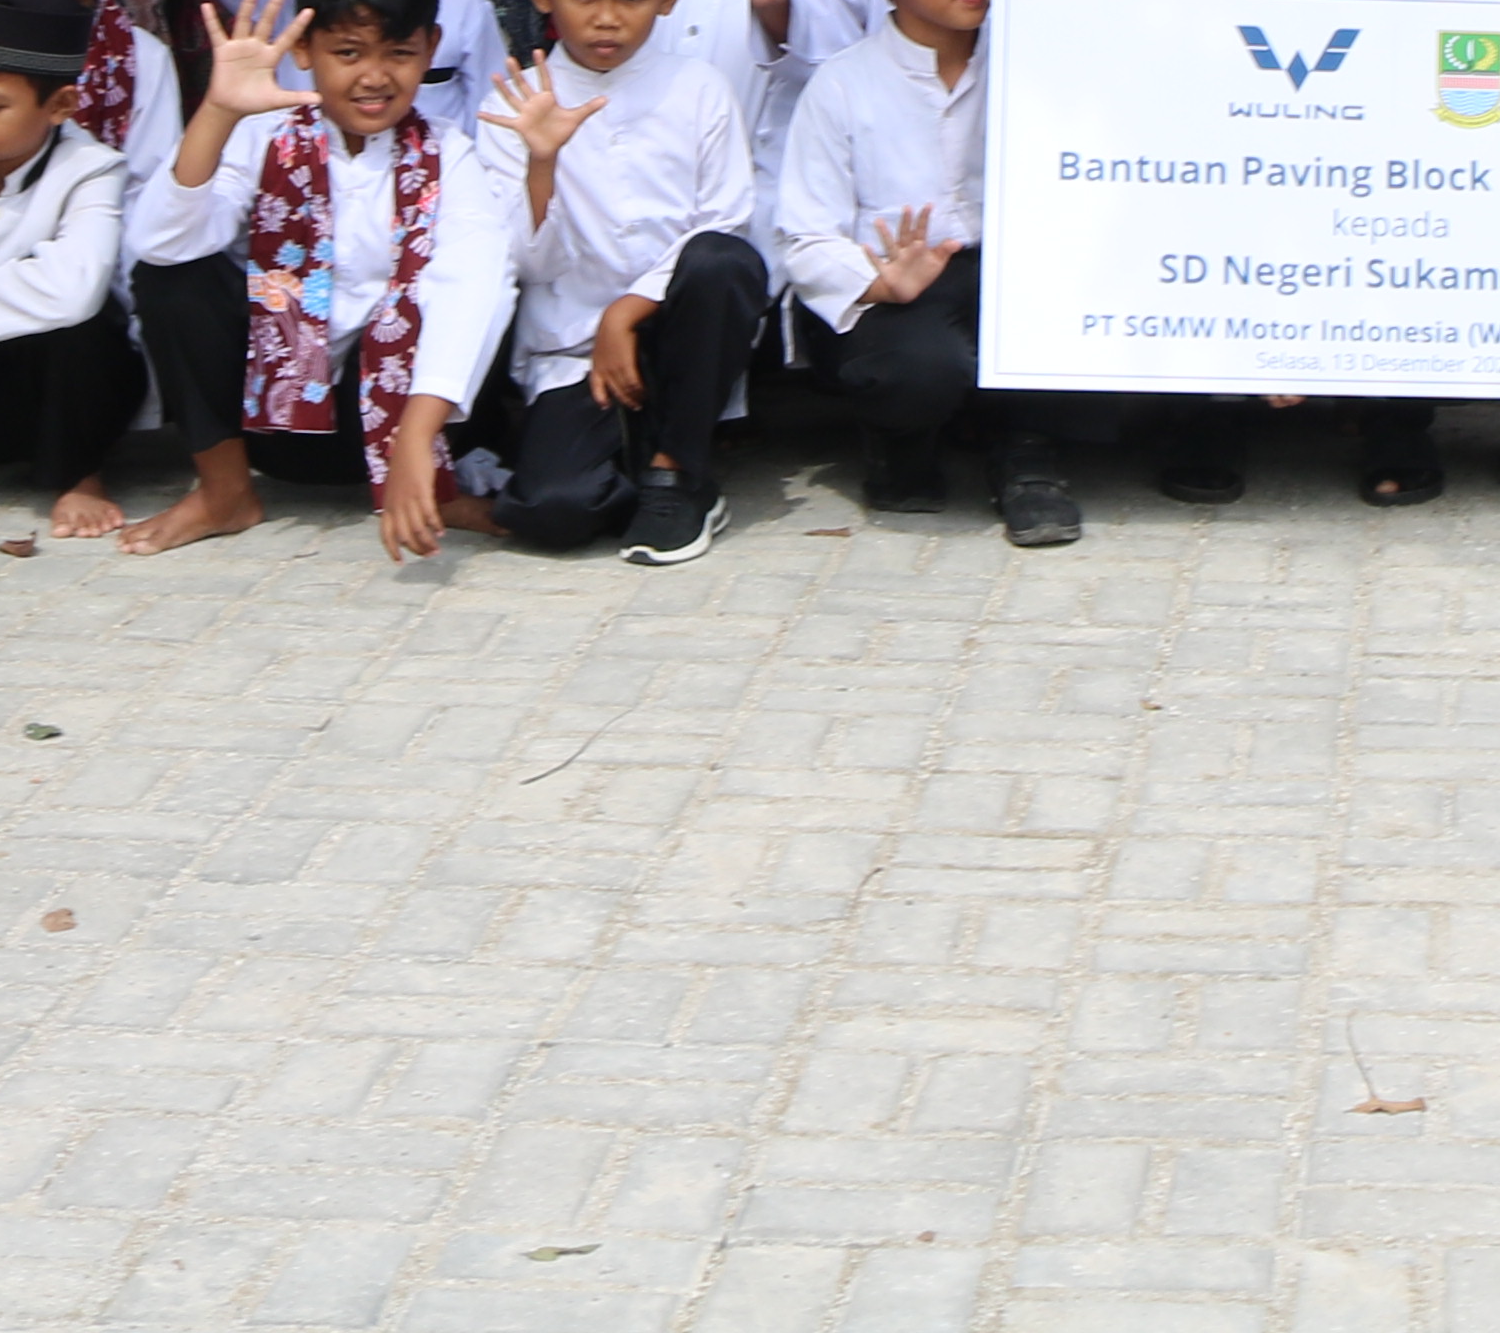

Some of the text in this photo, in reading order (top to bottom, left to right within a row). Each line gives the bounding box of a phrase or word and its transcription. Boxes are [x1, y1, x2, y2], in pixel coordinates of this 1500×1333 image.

[1228, 102, 1366, 120] WULING
[1059, 150, 1227, 184] Bantuan
[1242, 155, 1373, 199] Paving
[1386, 158, 1492, 192] Block
[1332, 208, 1450, 245] kepada
[1159, 253, 1208, 284] SD
[1223, 255, 1352, 295] Negeri
[1082, 314, 1115, 336] PT
[1124, 315, 1216, 339] SGMW
[1224, 317, 1312, 340] Motor
[1321, 319, 1459, 343] Indonesia
[1255, 351, 1326, 373] Selasa,
[1333, 353, 1356, 371] 13
[1362, 353, 1466, 373] Desember
